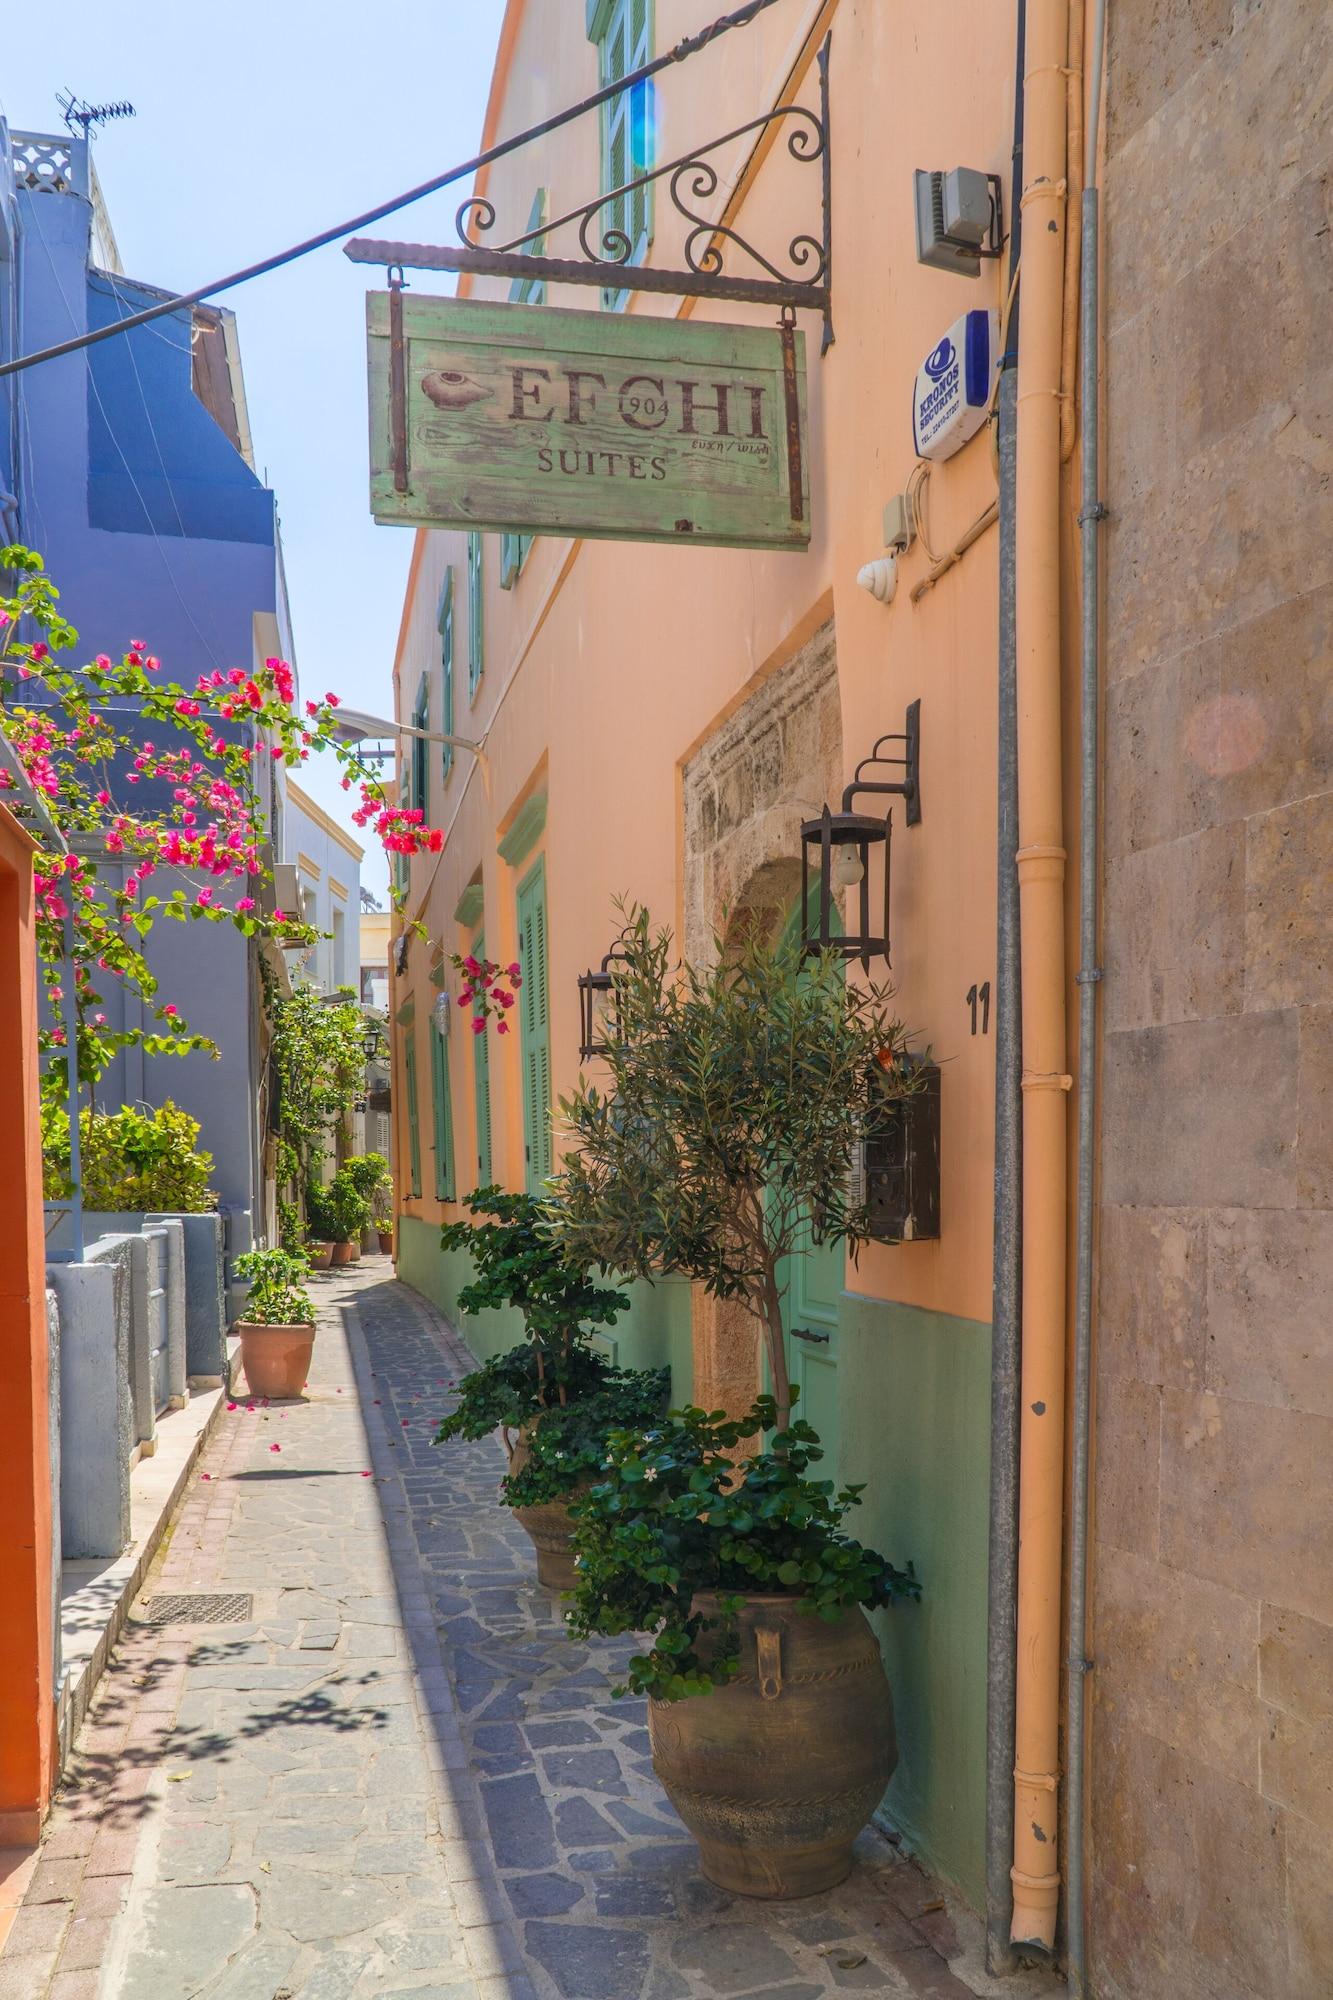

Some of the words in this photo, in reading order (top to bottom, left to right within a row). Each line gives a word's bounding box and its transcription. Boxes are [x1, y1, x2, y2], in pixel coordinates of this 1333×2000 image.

[505, 366, 770, 439] EFCHI
[617, 396, 669, 417] 1904
[920, 363, 959, 417] KRONOS
[920, 381, 959, 431] SECURITY
[538, 448, 666, 480] SUITES
[966, 981, 990, 1036] 11
